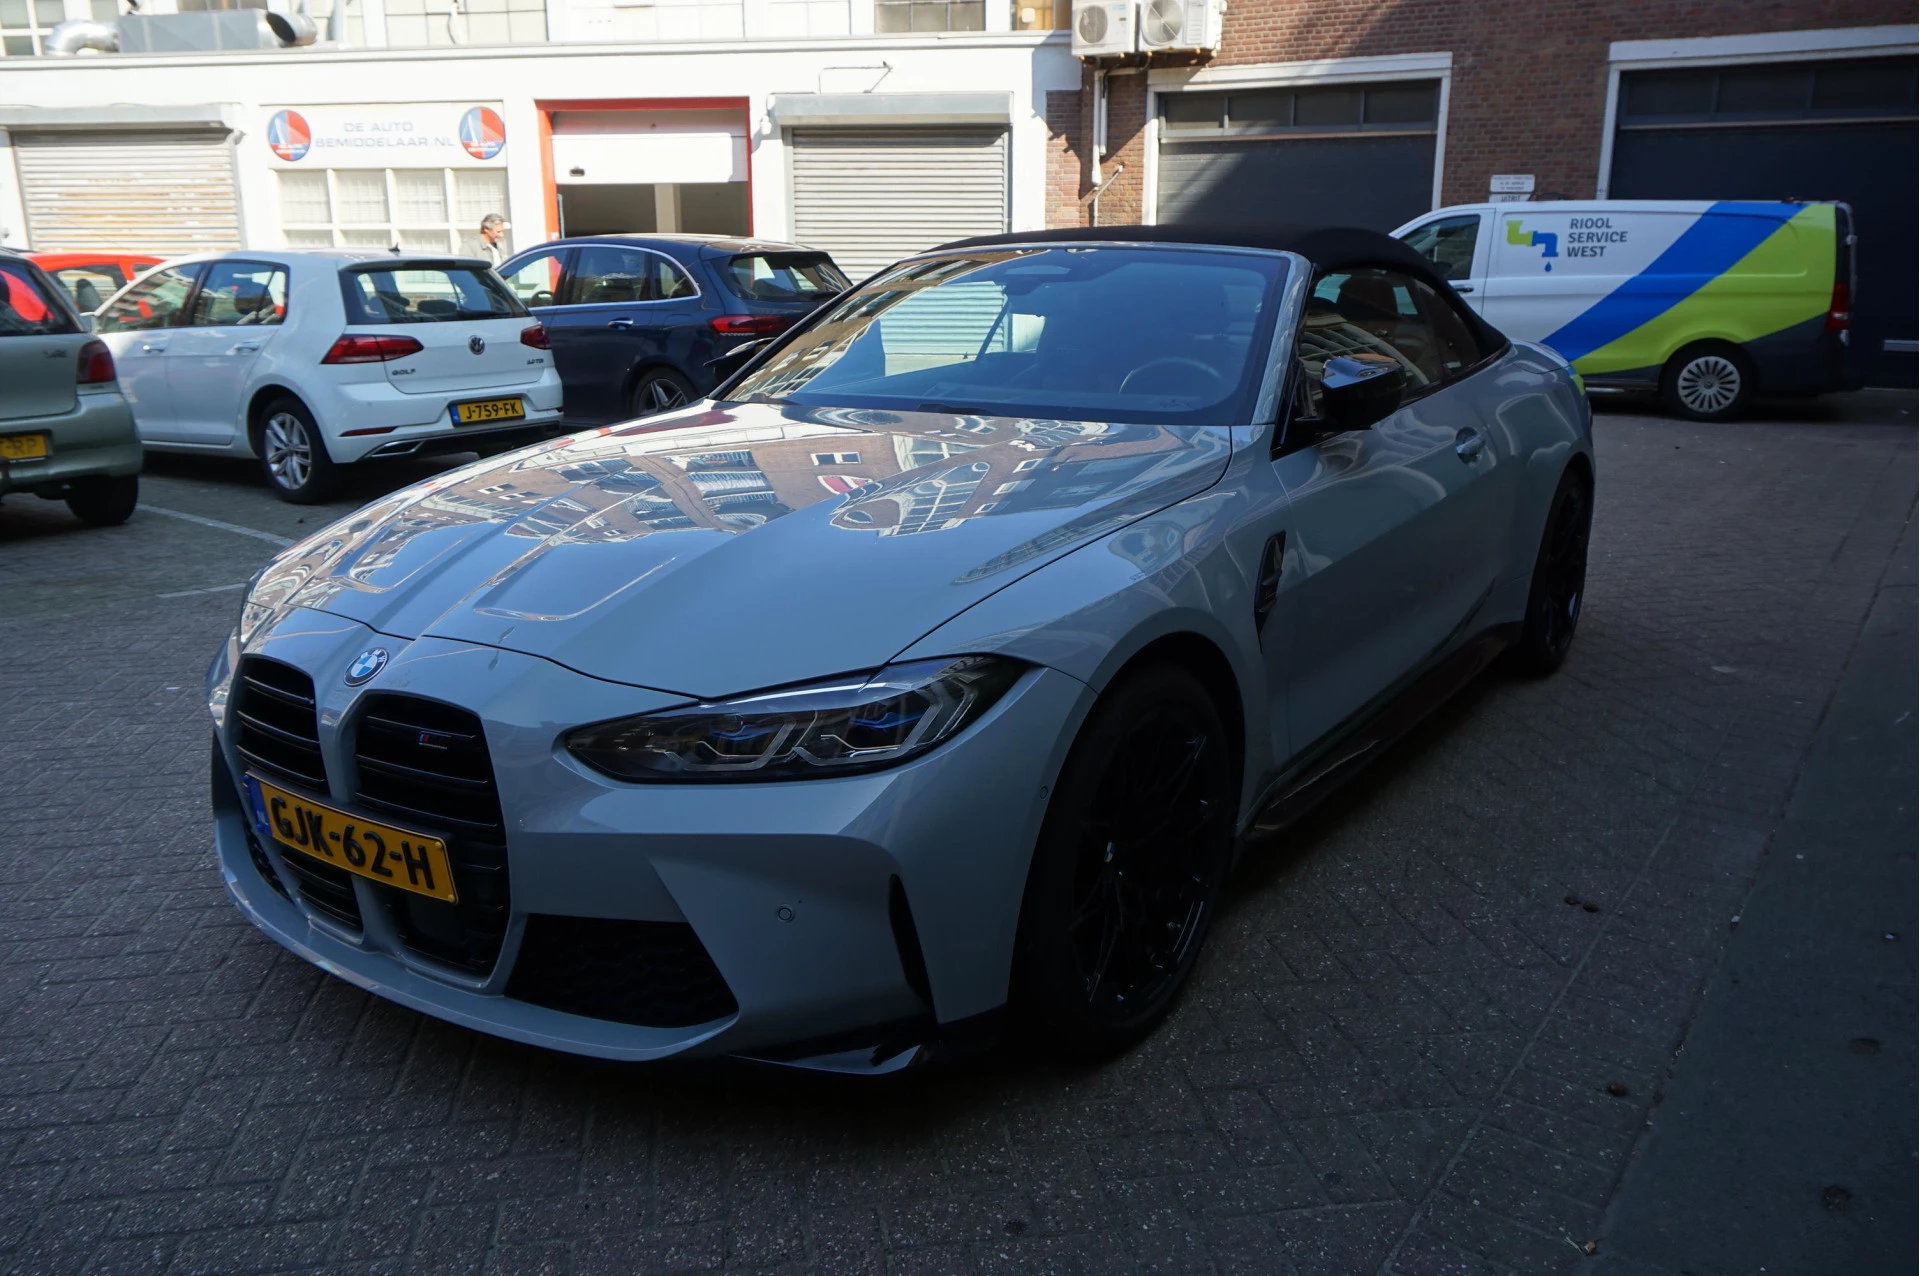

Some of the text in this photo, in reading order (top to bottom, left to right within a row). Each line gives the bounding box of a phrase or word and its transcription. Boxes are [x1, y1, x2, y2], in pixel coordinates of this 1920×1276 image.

[343, 121, 414, 132] DE AUTO
[1569, 217, 1613, 230] RIOOL
[1567, 231, 1628, 243] SERVICE
[1566, 246, 1607, 257] WEST
[391, 368, 416, 376] GOLF
[465, 401, 520, 420] J-759-FK
[269, 795, 436, 891] GJK-62-H
